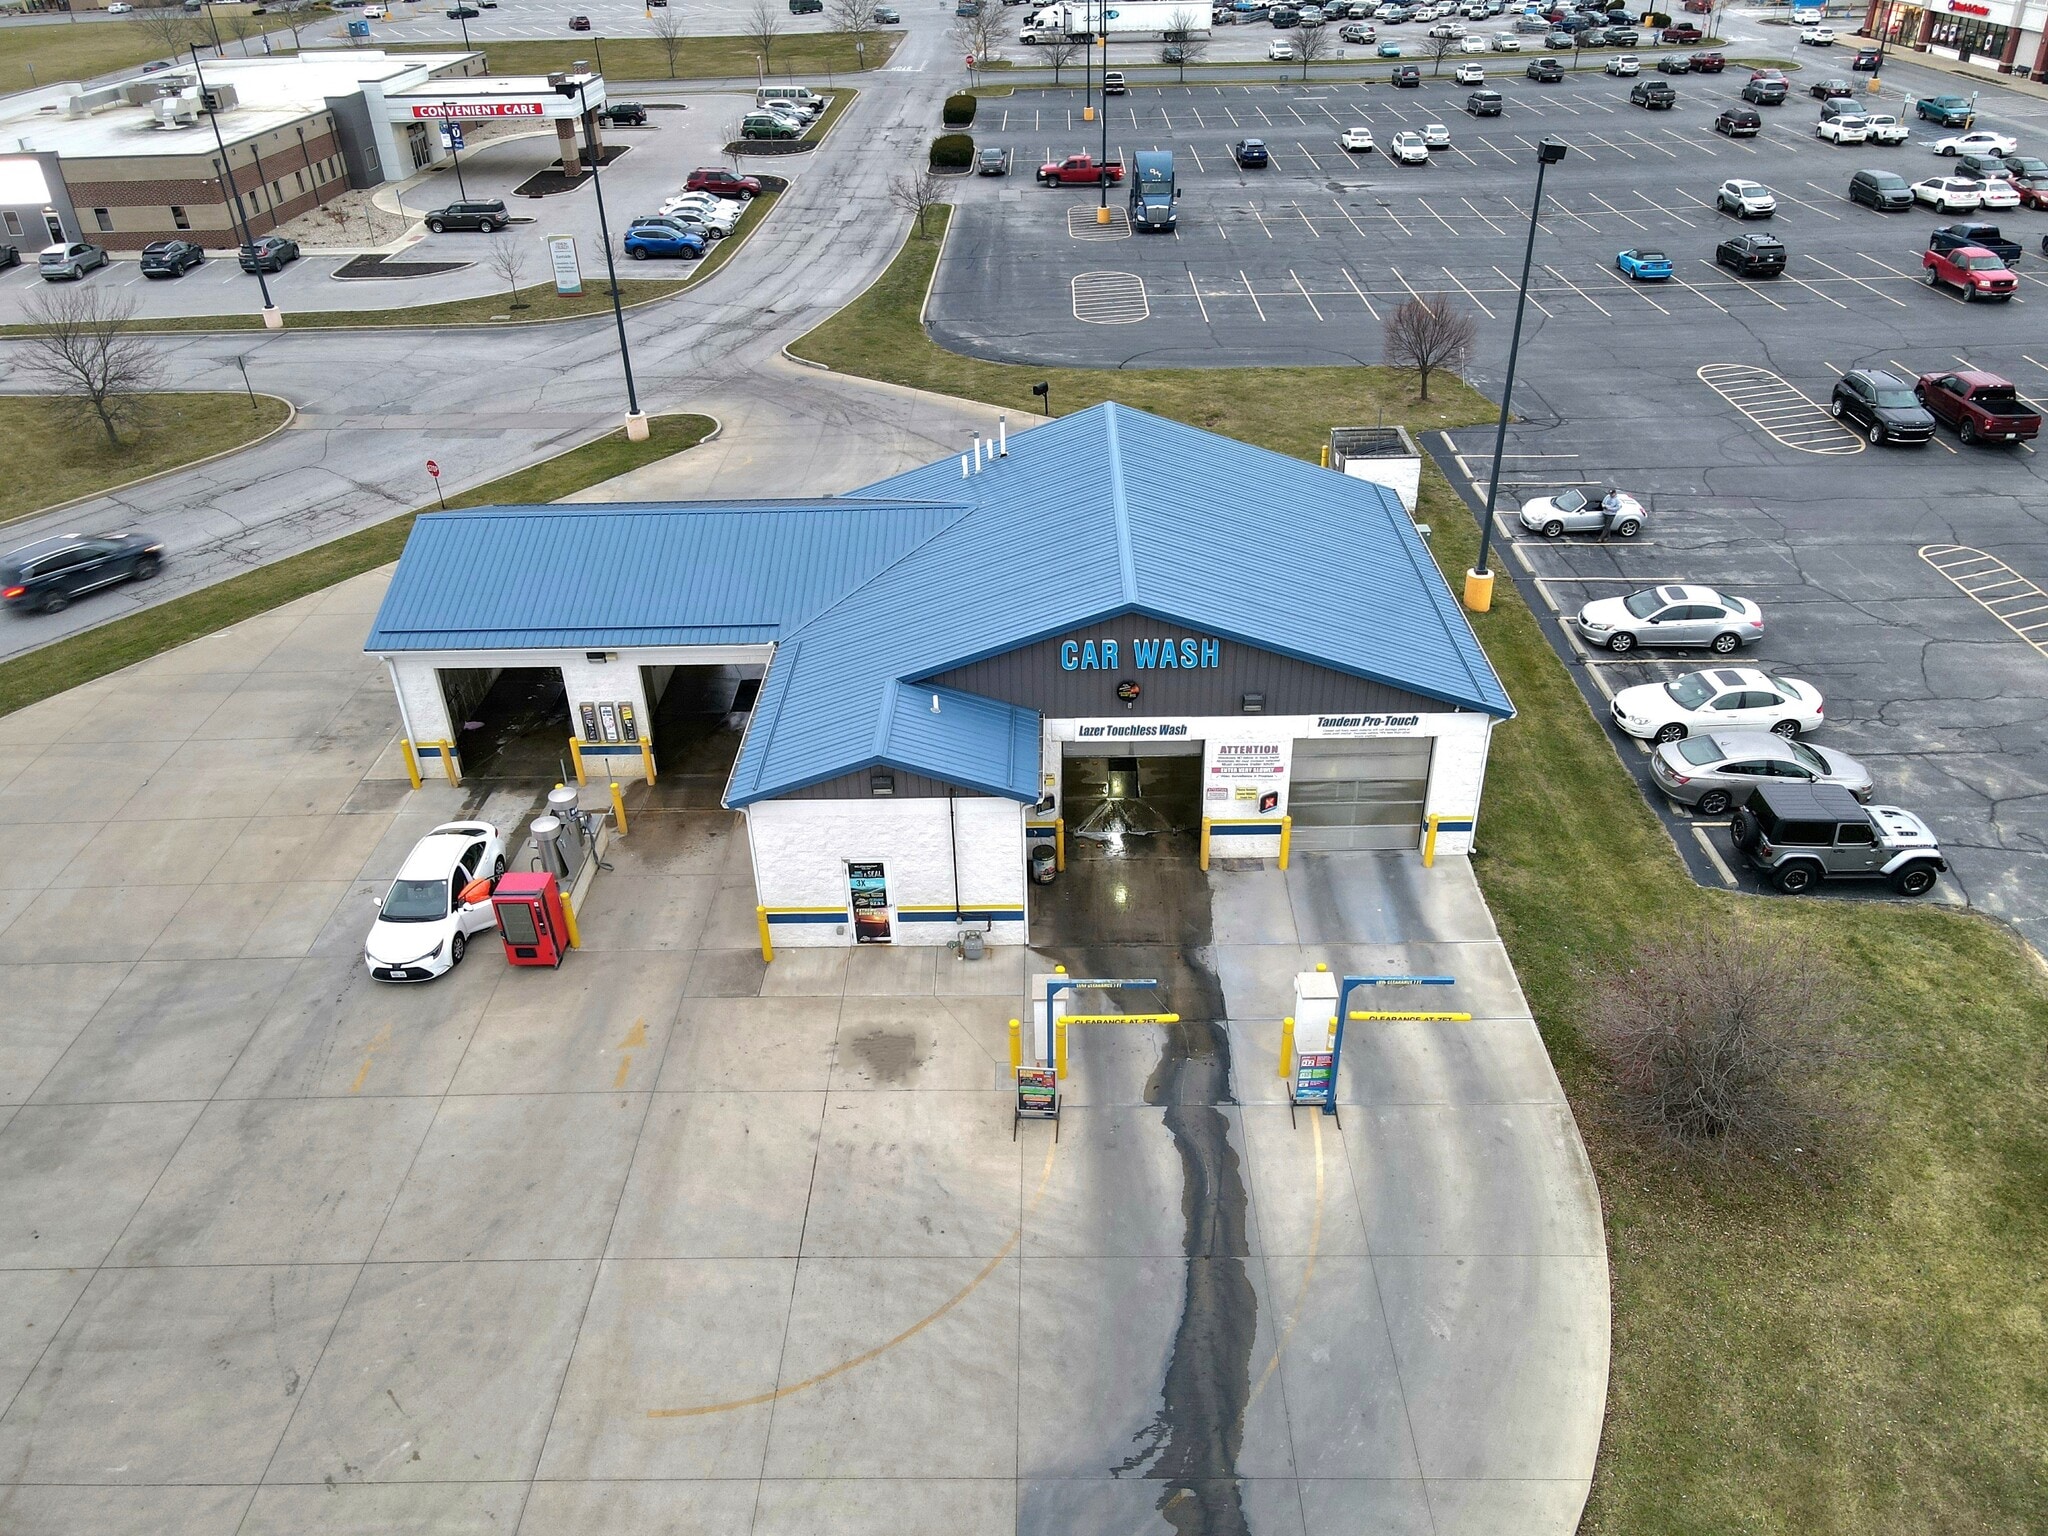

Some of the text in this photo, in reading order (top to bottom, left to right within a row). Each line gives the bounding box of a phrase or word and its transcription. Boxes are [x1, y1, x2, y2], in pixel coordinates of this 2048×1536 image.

[420, 104, 536, 117] CONVENIENT CARE
[1061, 637, 1220, 671] CAR WASH
[1317, 715, 1419, 727] Tandem Pro-Touch
[1079, 724, 1188, 736] Lazer Touchless Wash
[1220, 745, 1279, 754] ATTENTION
